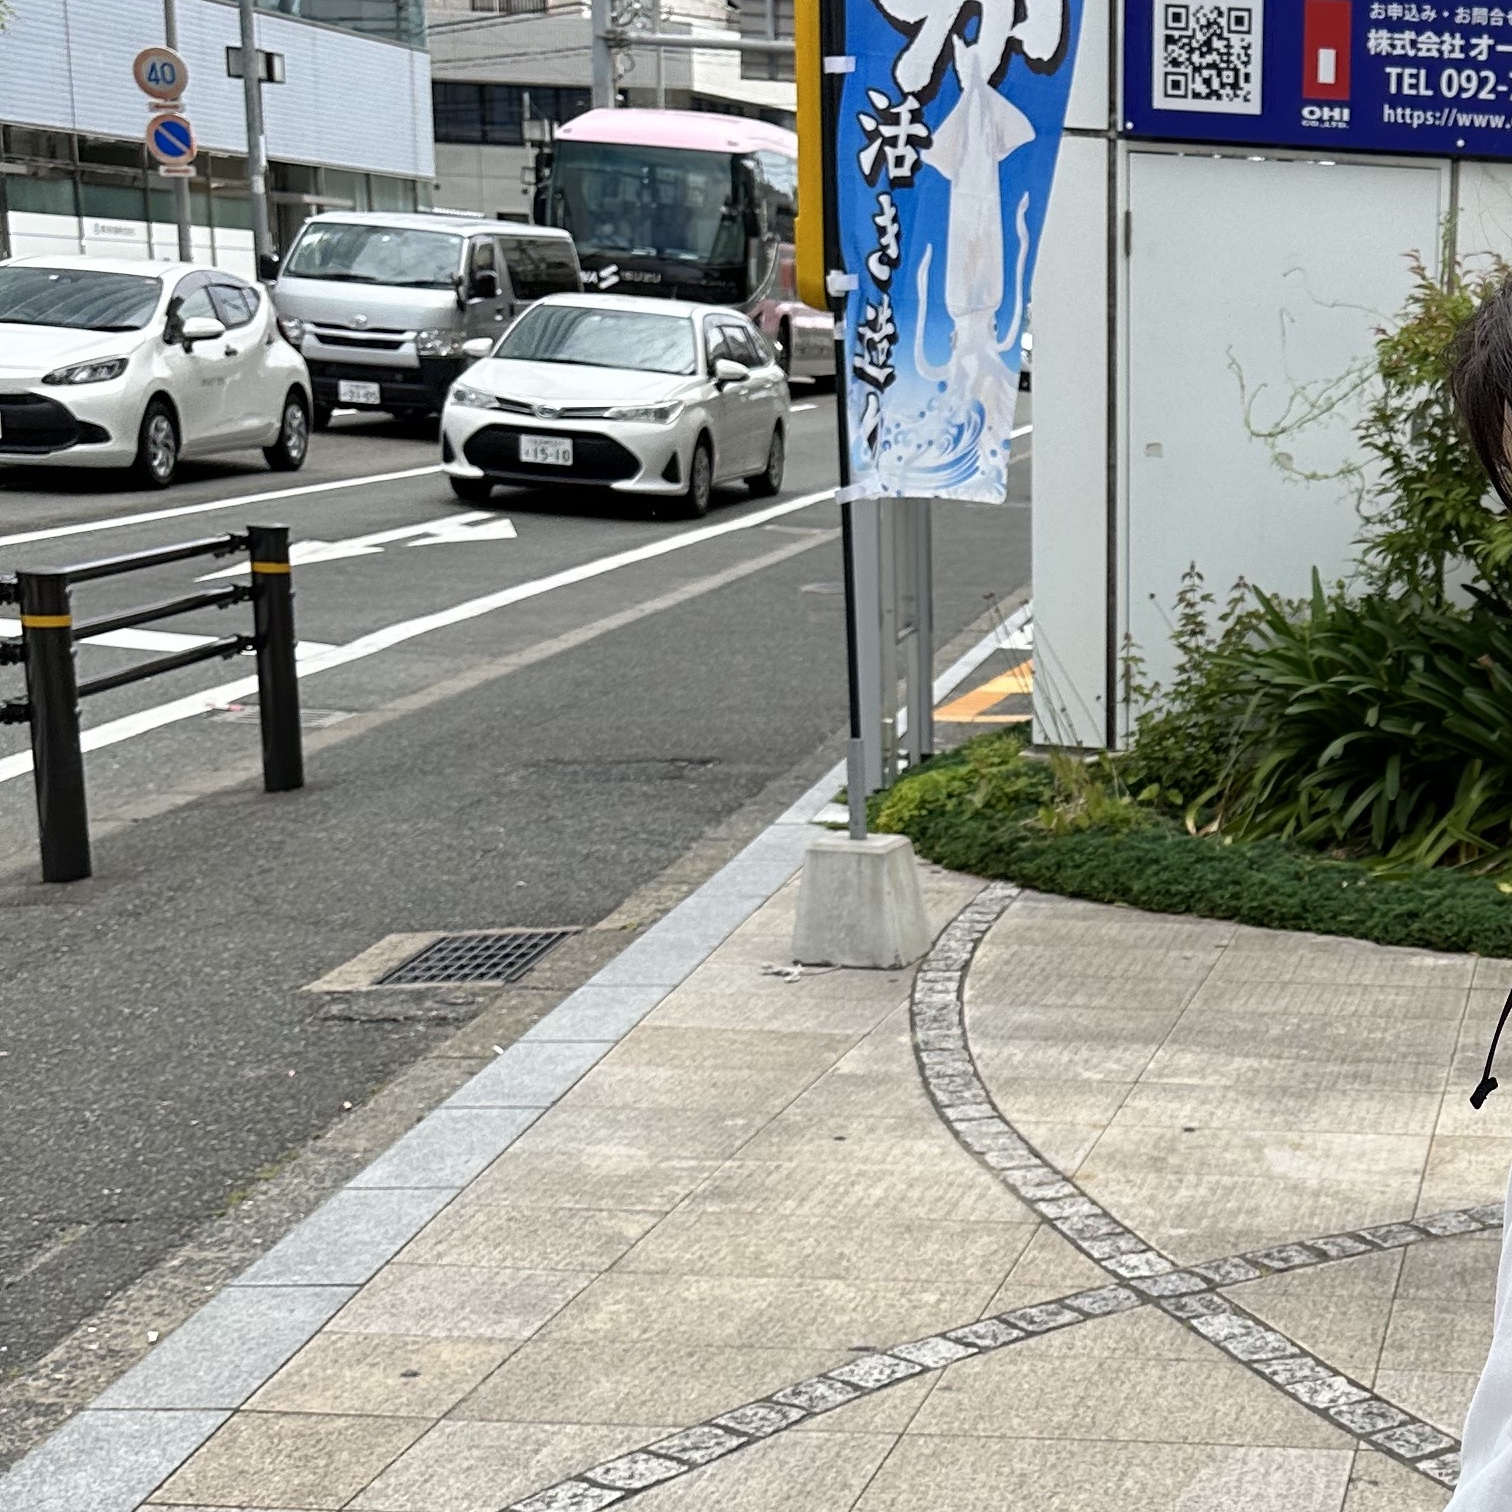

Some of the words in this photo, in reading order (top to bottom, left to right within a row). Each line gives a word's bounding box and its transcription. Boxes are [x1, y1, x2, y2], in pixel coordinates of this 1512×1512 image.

[147, 61, 176, 84] 40
[1384, 66, 1434, 96] TEL
[1301, 106, 1350, 121] OHI
